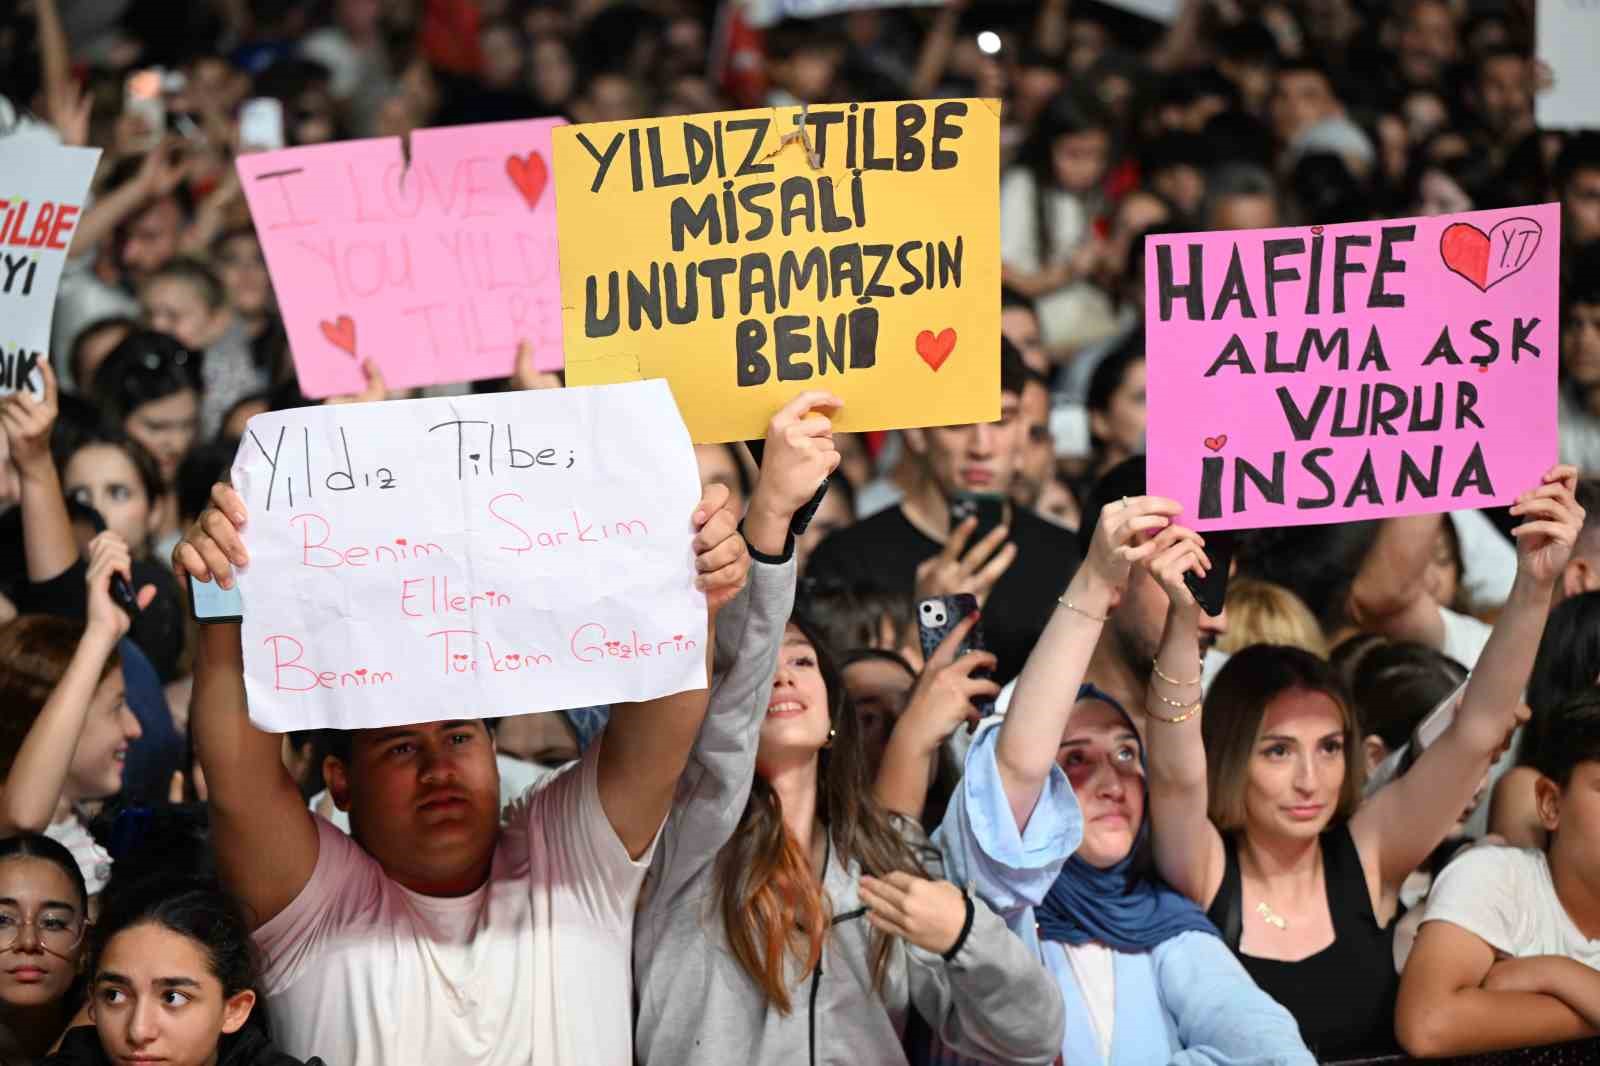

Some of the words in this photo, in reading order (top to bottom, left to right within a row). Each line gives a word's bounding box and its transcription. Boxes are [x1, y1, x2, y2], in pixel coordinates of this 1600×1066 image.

[576, 118, 775, 193] YILDIZ
[792, 102, 968, 173] TİLBE
[344, 155, 497, 224] LOVE
[670, 168, 866, 251] MİSALİ
[436, 229, 559, 291] YILD
[584, 235, 963, 338] UNUTAMAZSIN
[1156, 225, 1416, 321] HAFİFE
[736, 296, 880, 387] BENİ
[1203, 324, 1391, 377] ALMA
[1421, 317, 1541, 374] AŞK
[1276, 382, 1485, 442] VURUR
[249, 425, 399, 511] Yıldız
[428, 420, 576, 481] Tilbe;
[1198, 434, 1496, 520] İNSANA
[289, 513, 444, 568] Benim
[401, 575, 513, 617] Ellerin
[264, 634, 393, 691] Benim
[570, 622, 697, 662] Gözlerin
